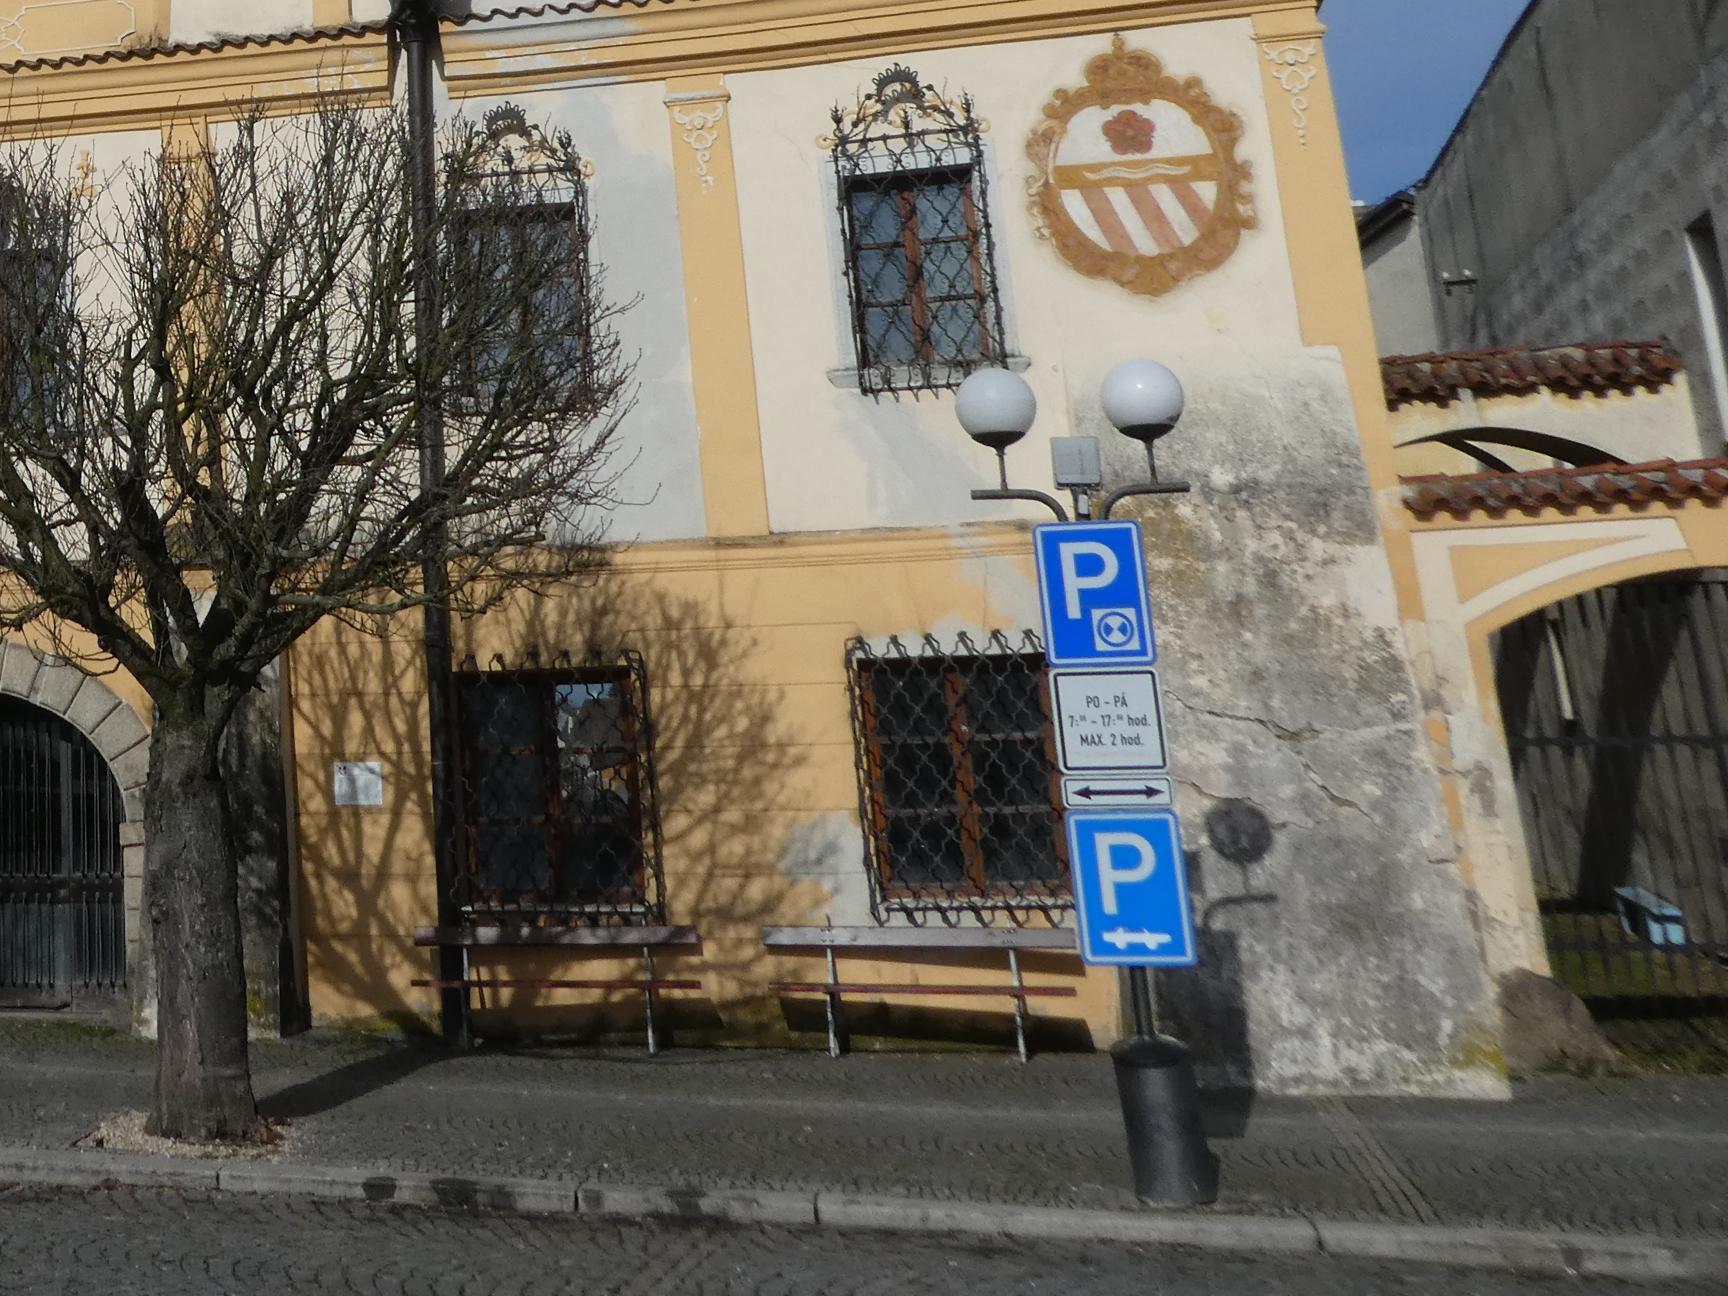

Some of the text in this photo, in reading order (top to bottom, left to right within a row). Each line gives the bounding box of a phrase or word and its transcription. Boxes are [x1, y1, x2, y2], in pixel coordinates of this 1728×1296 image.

[1059, 541, 1119, 620] P
[1086, 695, 1100, 708] PO
[1113, 691, 1128, 708] PÁ
[1127, 714, 1151, 727] hod.
[1079, 733, 1144, 746] MAX. 2 hod.
[1094, 832, 1156, 915] P
